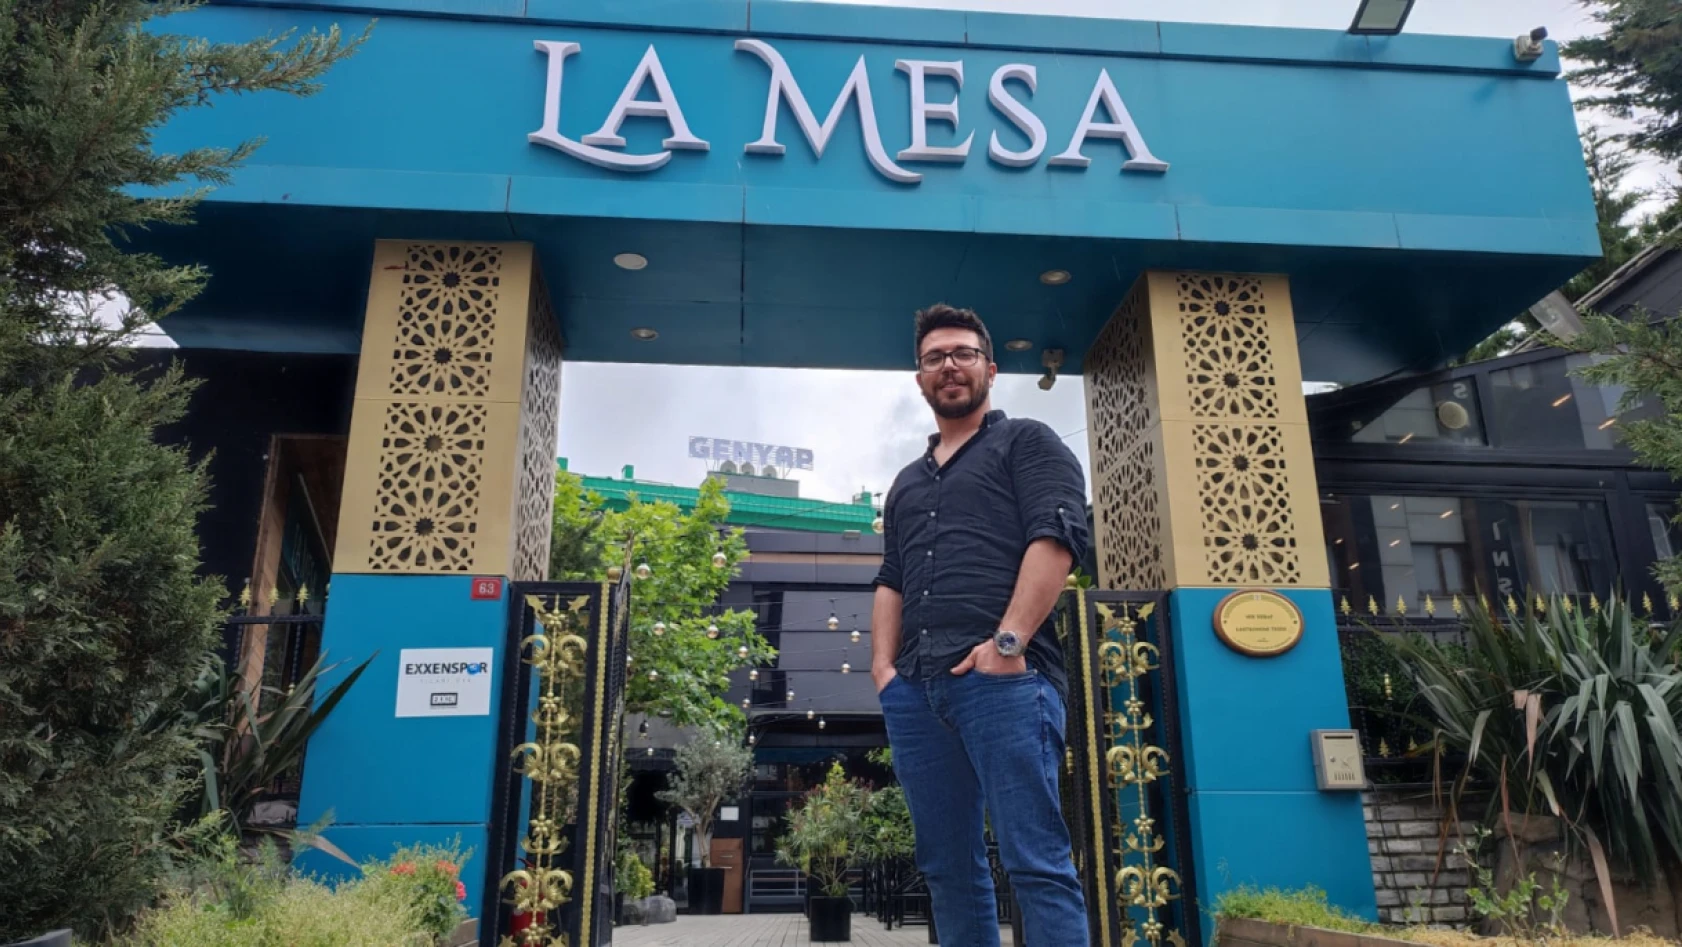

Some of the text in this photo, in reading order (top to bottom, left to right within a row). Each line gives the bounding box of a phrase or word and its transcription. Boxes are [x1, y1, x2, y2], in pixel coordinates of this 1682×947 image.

[527, 39, 1170, 184] LA MESA
[688, 436, 814, 470] GENYAP
[478, 583, 495, 595] 63
